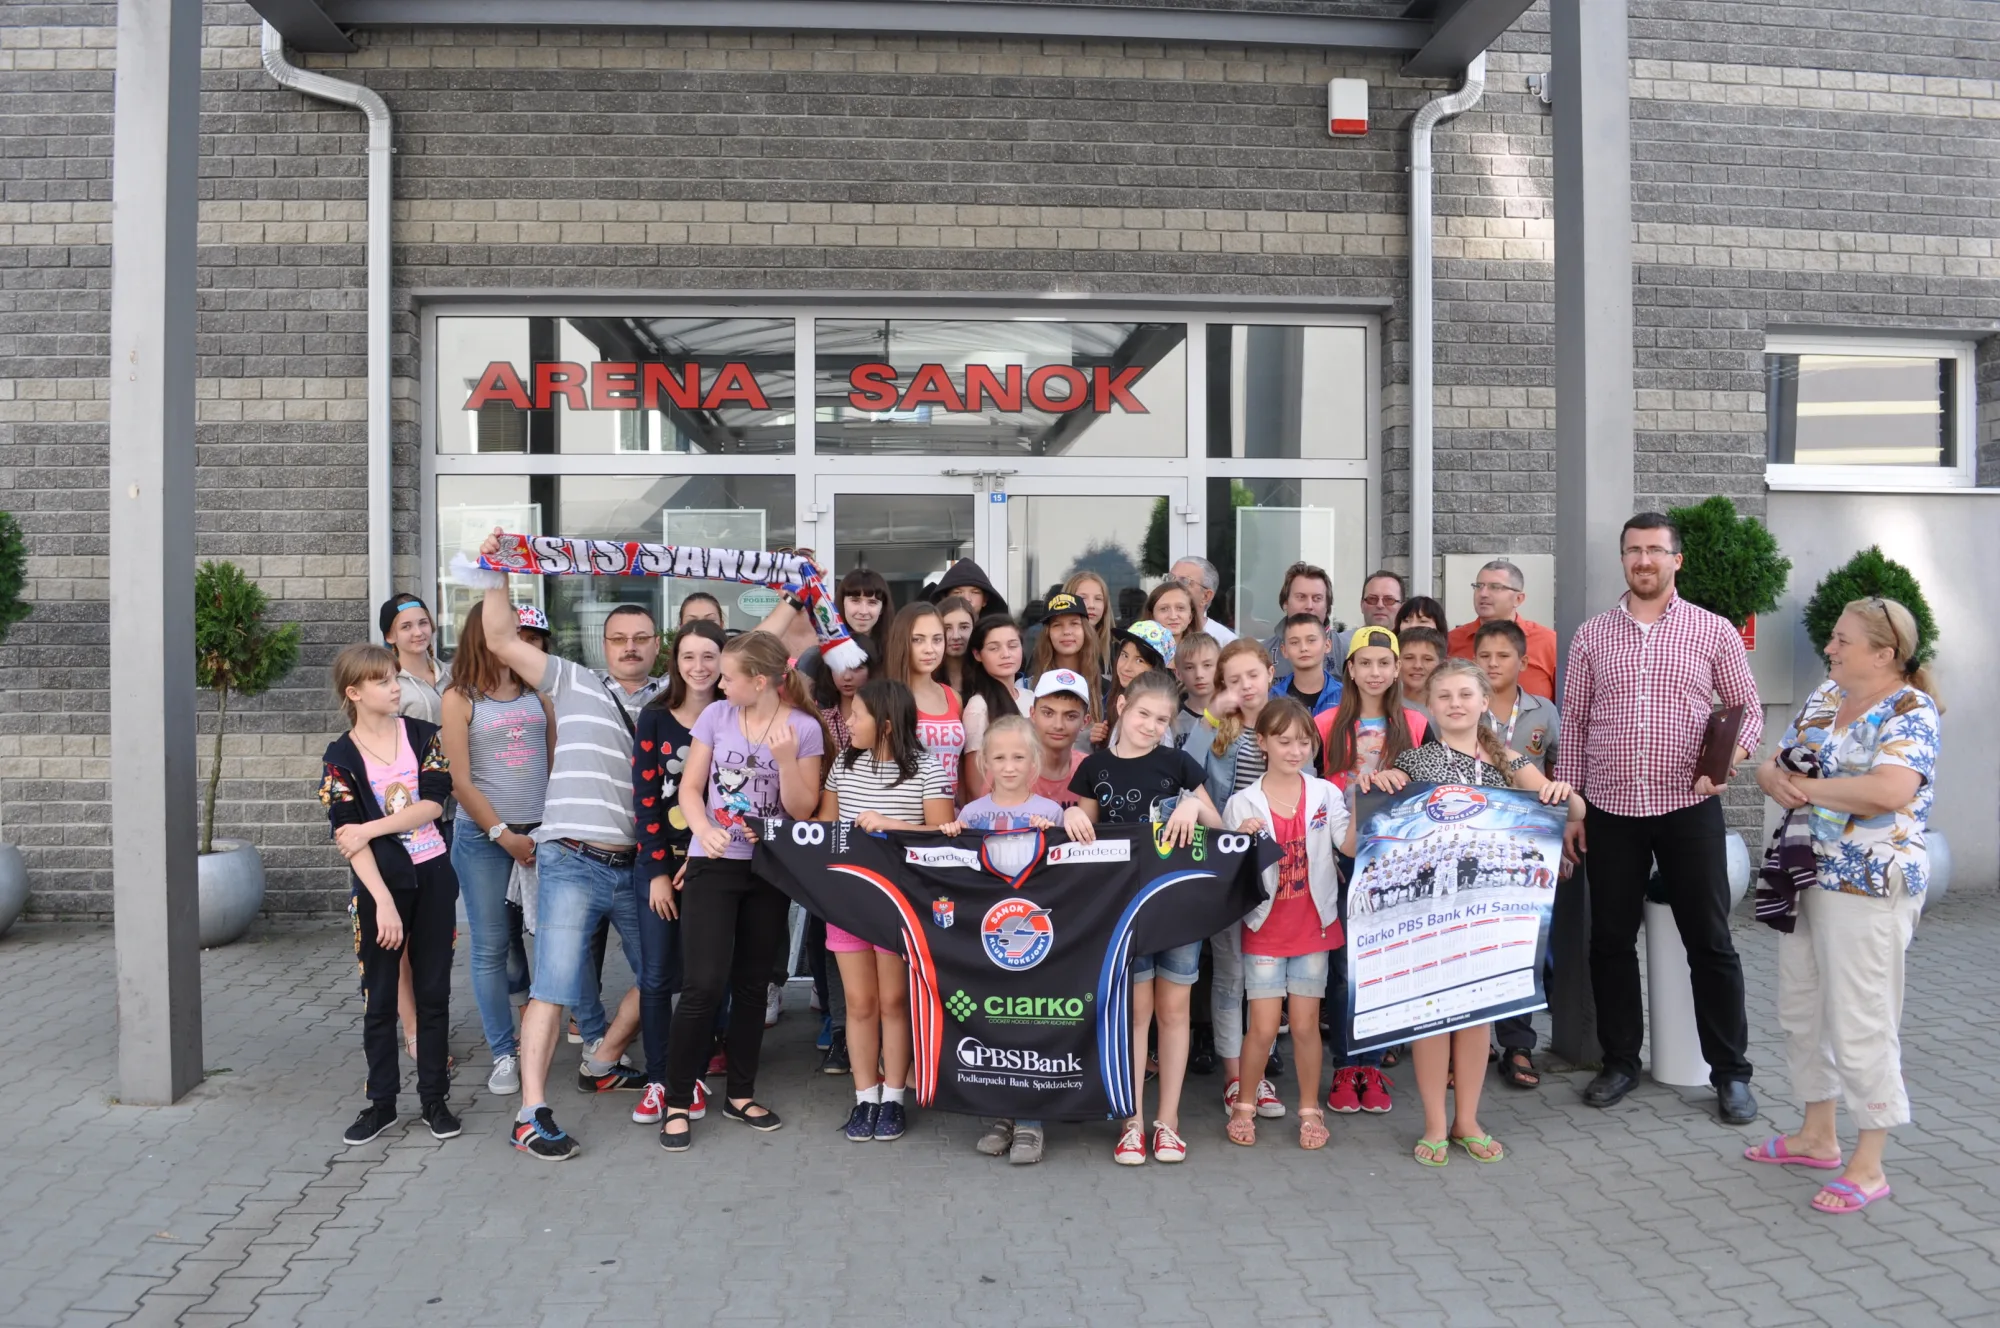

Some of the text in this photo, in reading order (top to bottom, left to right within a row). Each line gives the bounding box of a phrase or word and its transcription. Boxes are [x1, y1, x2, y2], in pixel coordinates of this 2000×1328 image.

[462, 361, 1151, 413] ARENA SANOK
[993, 494, 1003, 502] 15
[532, 537, 628, 573] STS
[1434, 786, 1466, 797] SANOK
[1429, 806, 1442, 819] KLUB
[791, 821, 825, 846] 8
[1438, 823, 1465, 833] 2015
[1217, 833, 1251, 854] 8
[990, 904, 1025, 925] SANOK
[1357, 901, 1540, 948] Ciarko PBS Bank KH Sanok
[988, 937, 1004, 959] KLUB
[1007, 937, 1046, 965] HOKEJOWY
[957, 1073, 1084, 1092] Podkarpacki Bank Spółdzielczy
